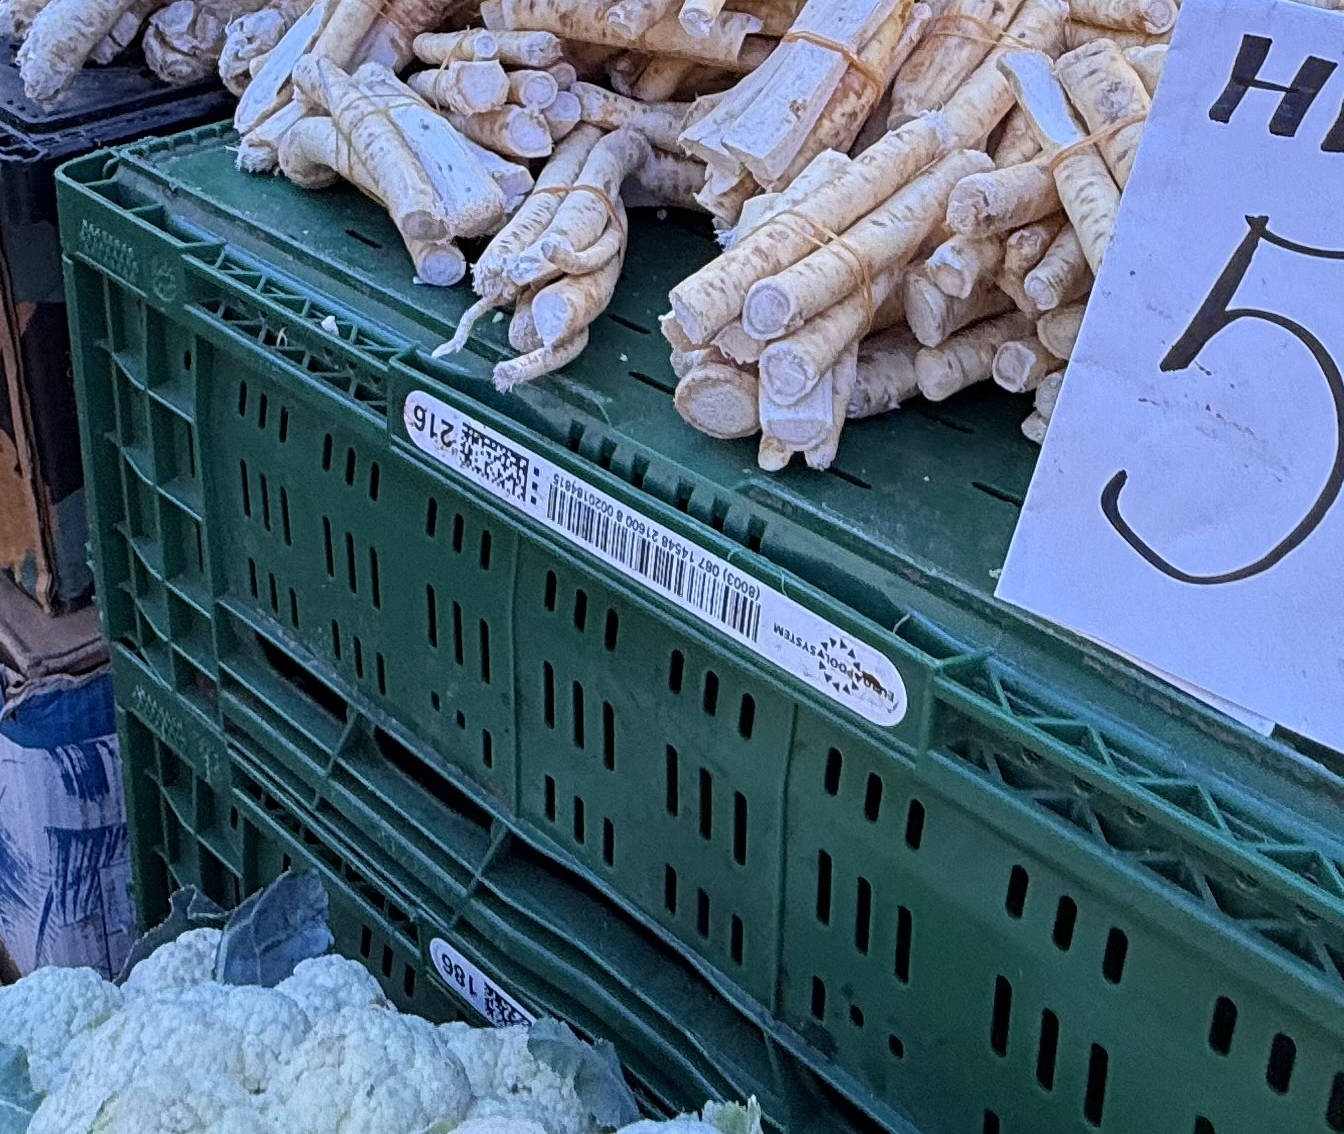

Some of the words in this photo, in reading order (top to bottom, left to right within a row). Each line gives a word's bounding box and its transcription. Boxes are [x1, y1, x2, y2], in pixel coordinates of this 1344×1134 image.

[412, 404, 456, 450] 216
[625, 515, 659, 543] 21600
[697, 557, 720, 578] 087
[722, 567, 761, 601] (8003)
[773, 623, 819, 657] SYSTEM
[440, 952, 478, 998] 186
